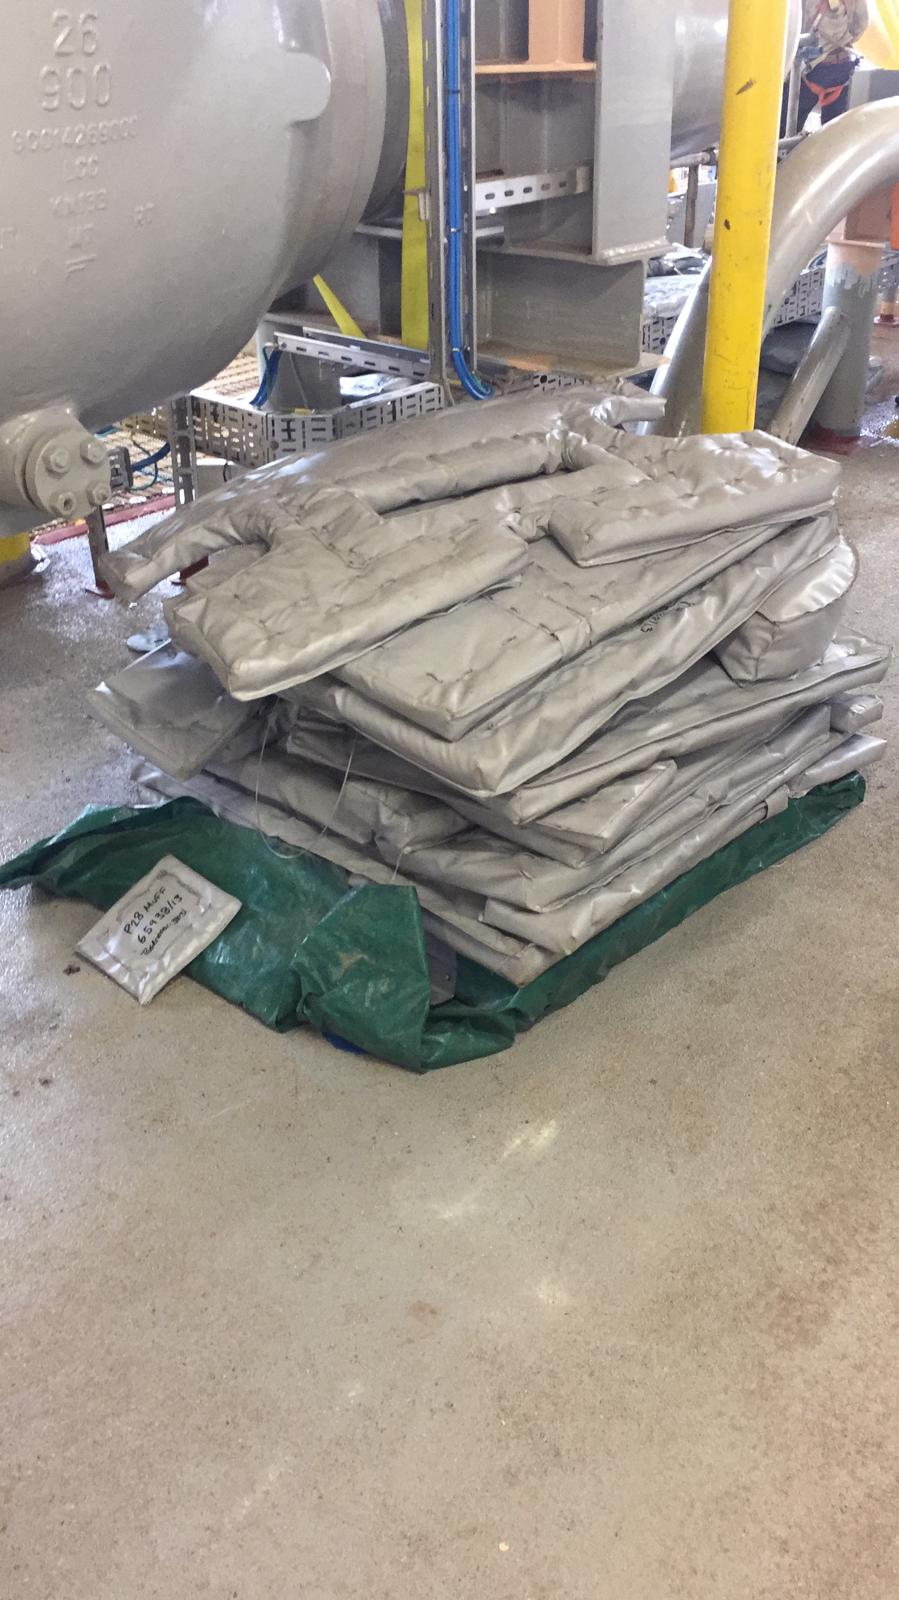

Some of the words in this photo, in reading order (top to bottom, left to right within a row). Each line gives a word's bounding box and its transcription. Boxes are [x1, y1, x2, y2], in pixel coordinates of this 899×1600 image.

[51, 8, 99, 57] 26
[39, 62, 112, 112] 900
[123, 911, 144, 935] P28
